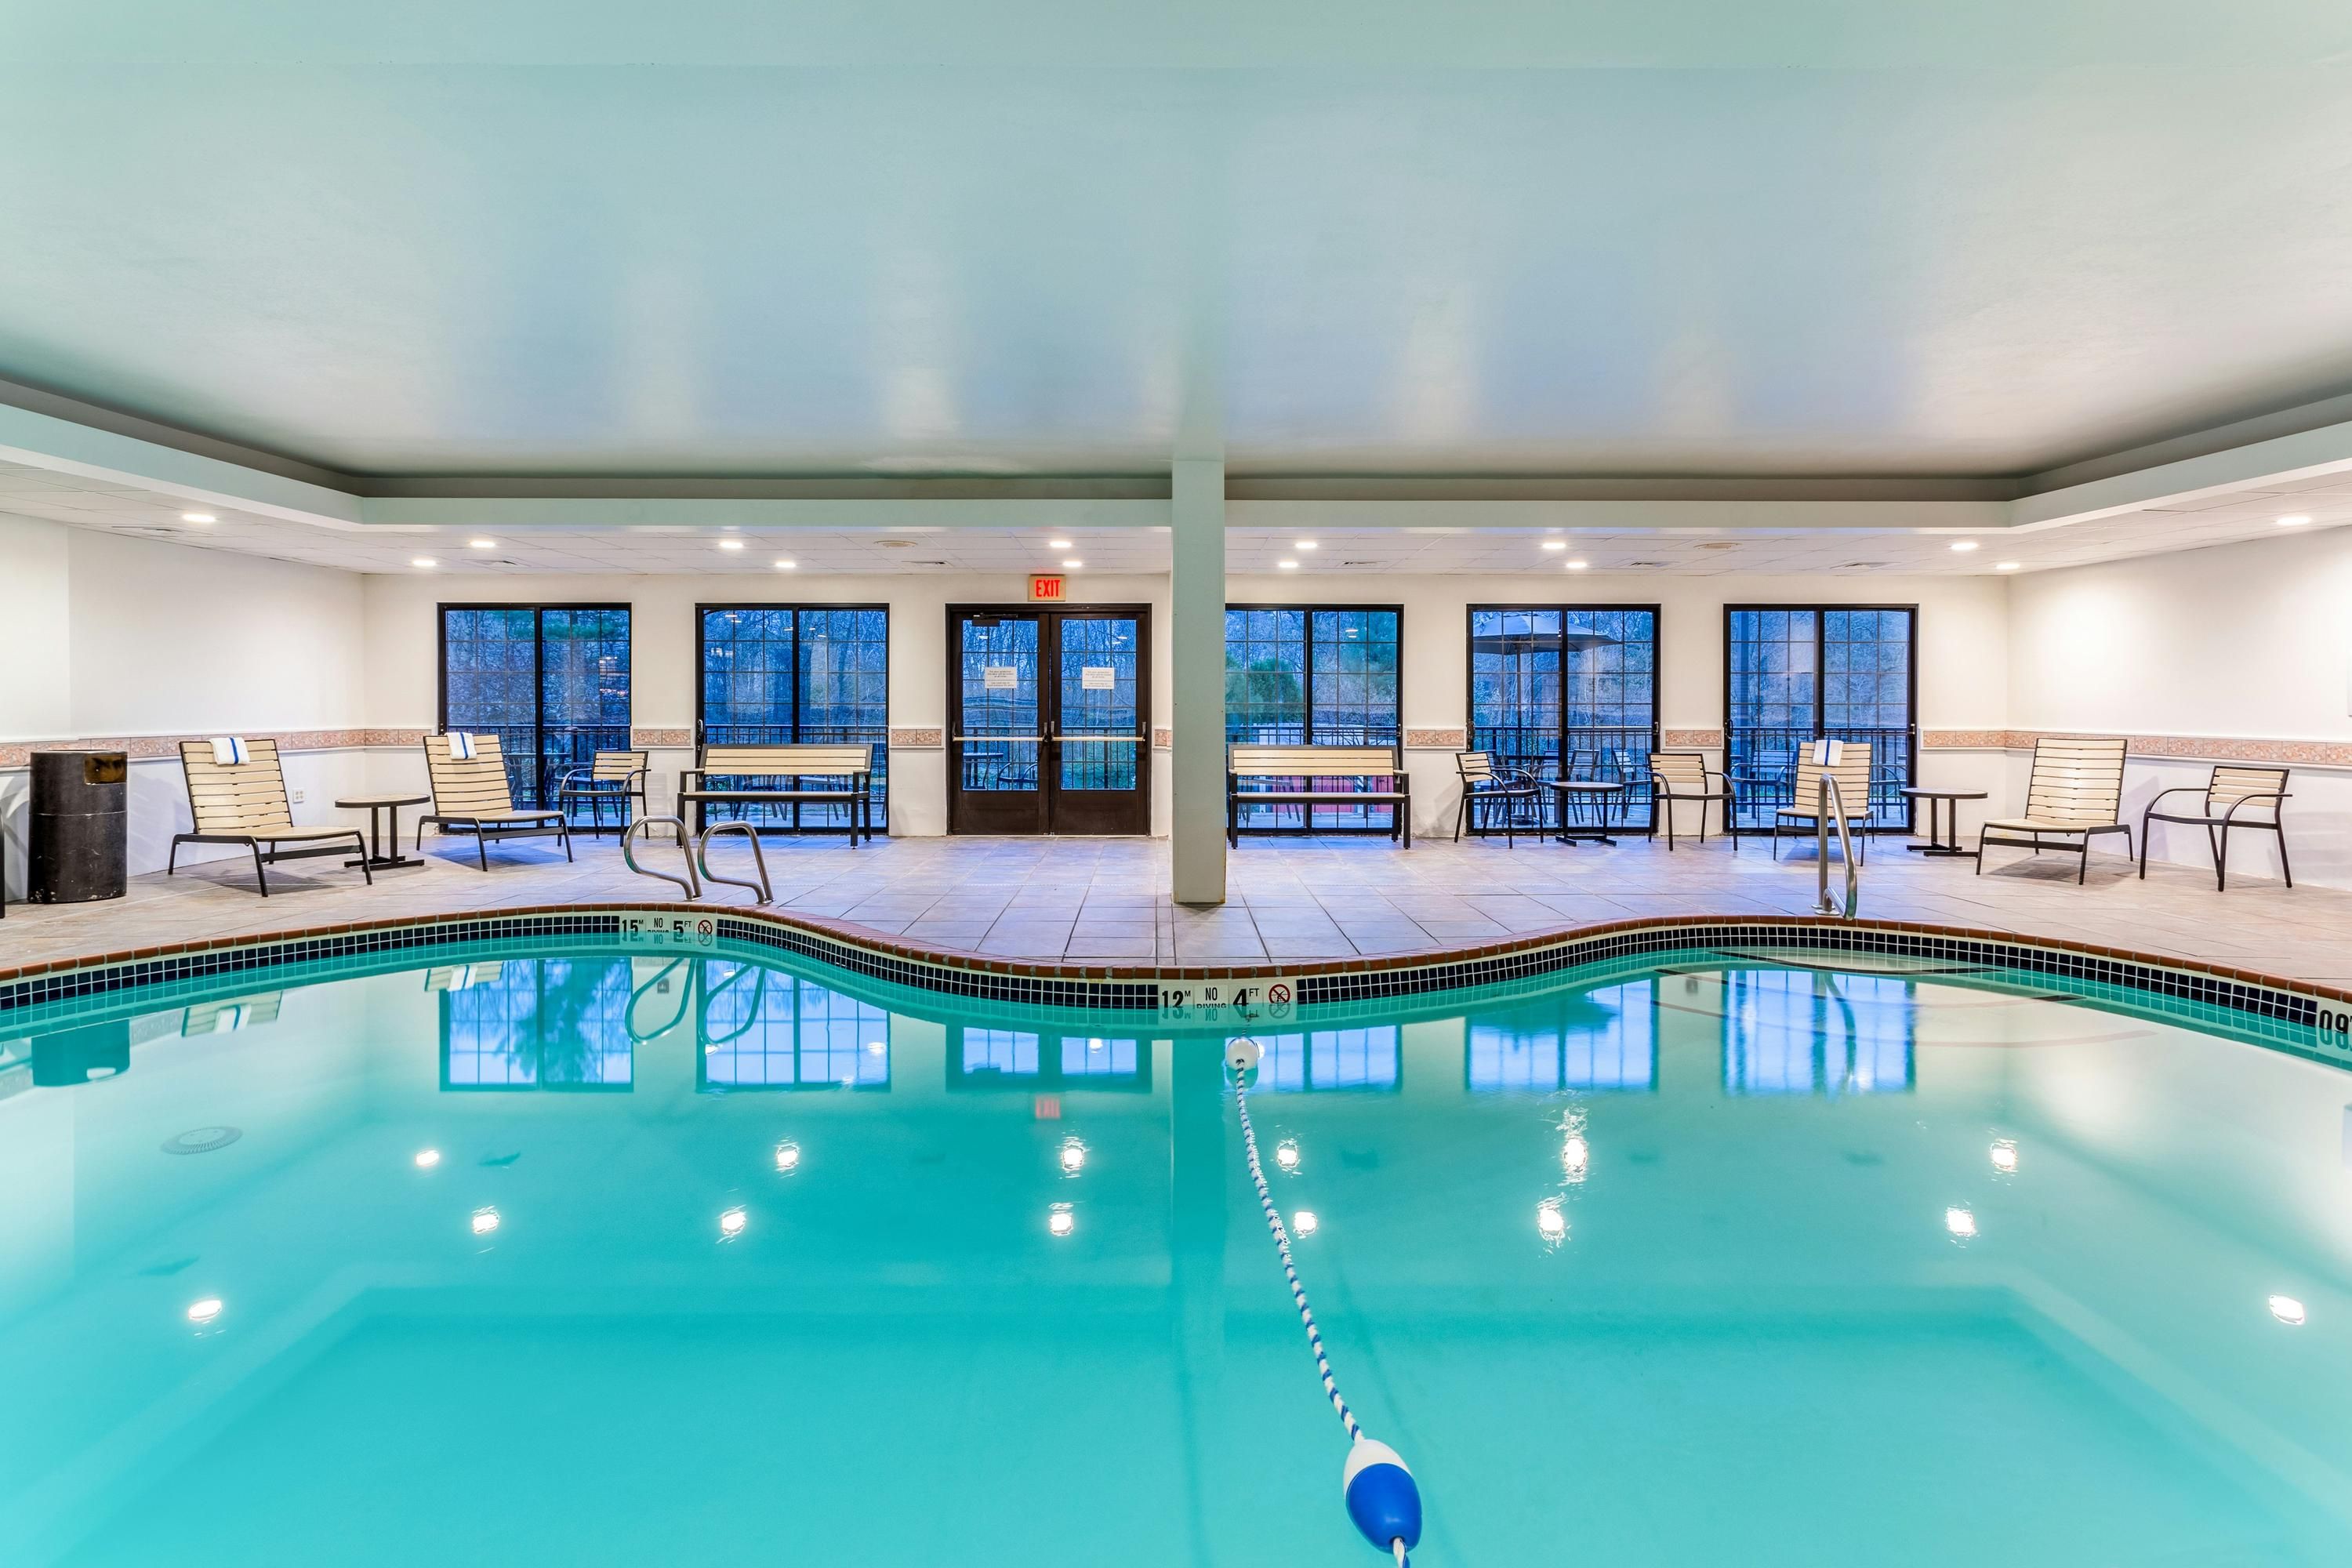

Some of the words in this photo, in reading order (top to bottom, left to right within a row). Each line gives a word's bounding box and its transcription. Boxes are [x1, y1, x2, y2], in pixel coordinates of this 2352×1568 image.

[1036, 579, 1061, 597] EXIT
[654, 917, 663, 928] NO
[1205, 987, 1218, 1001] NO
